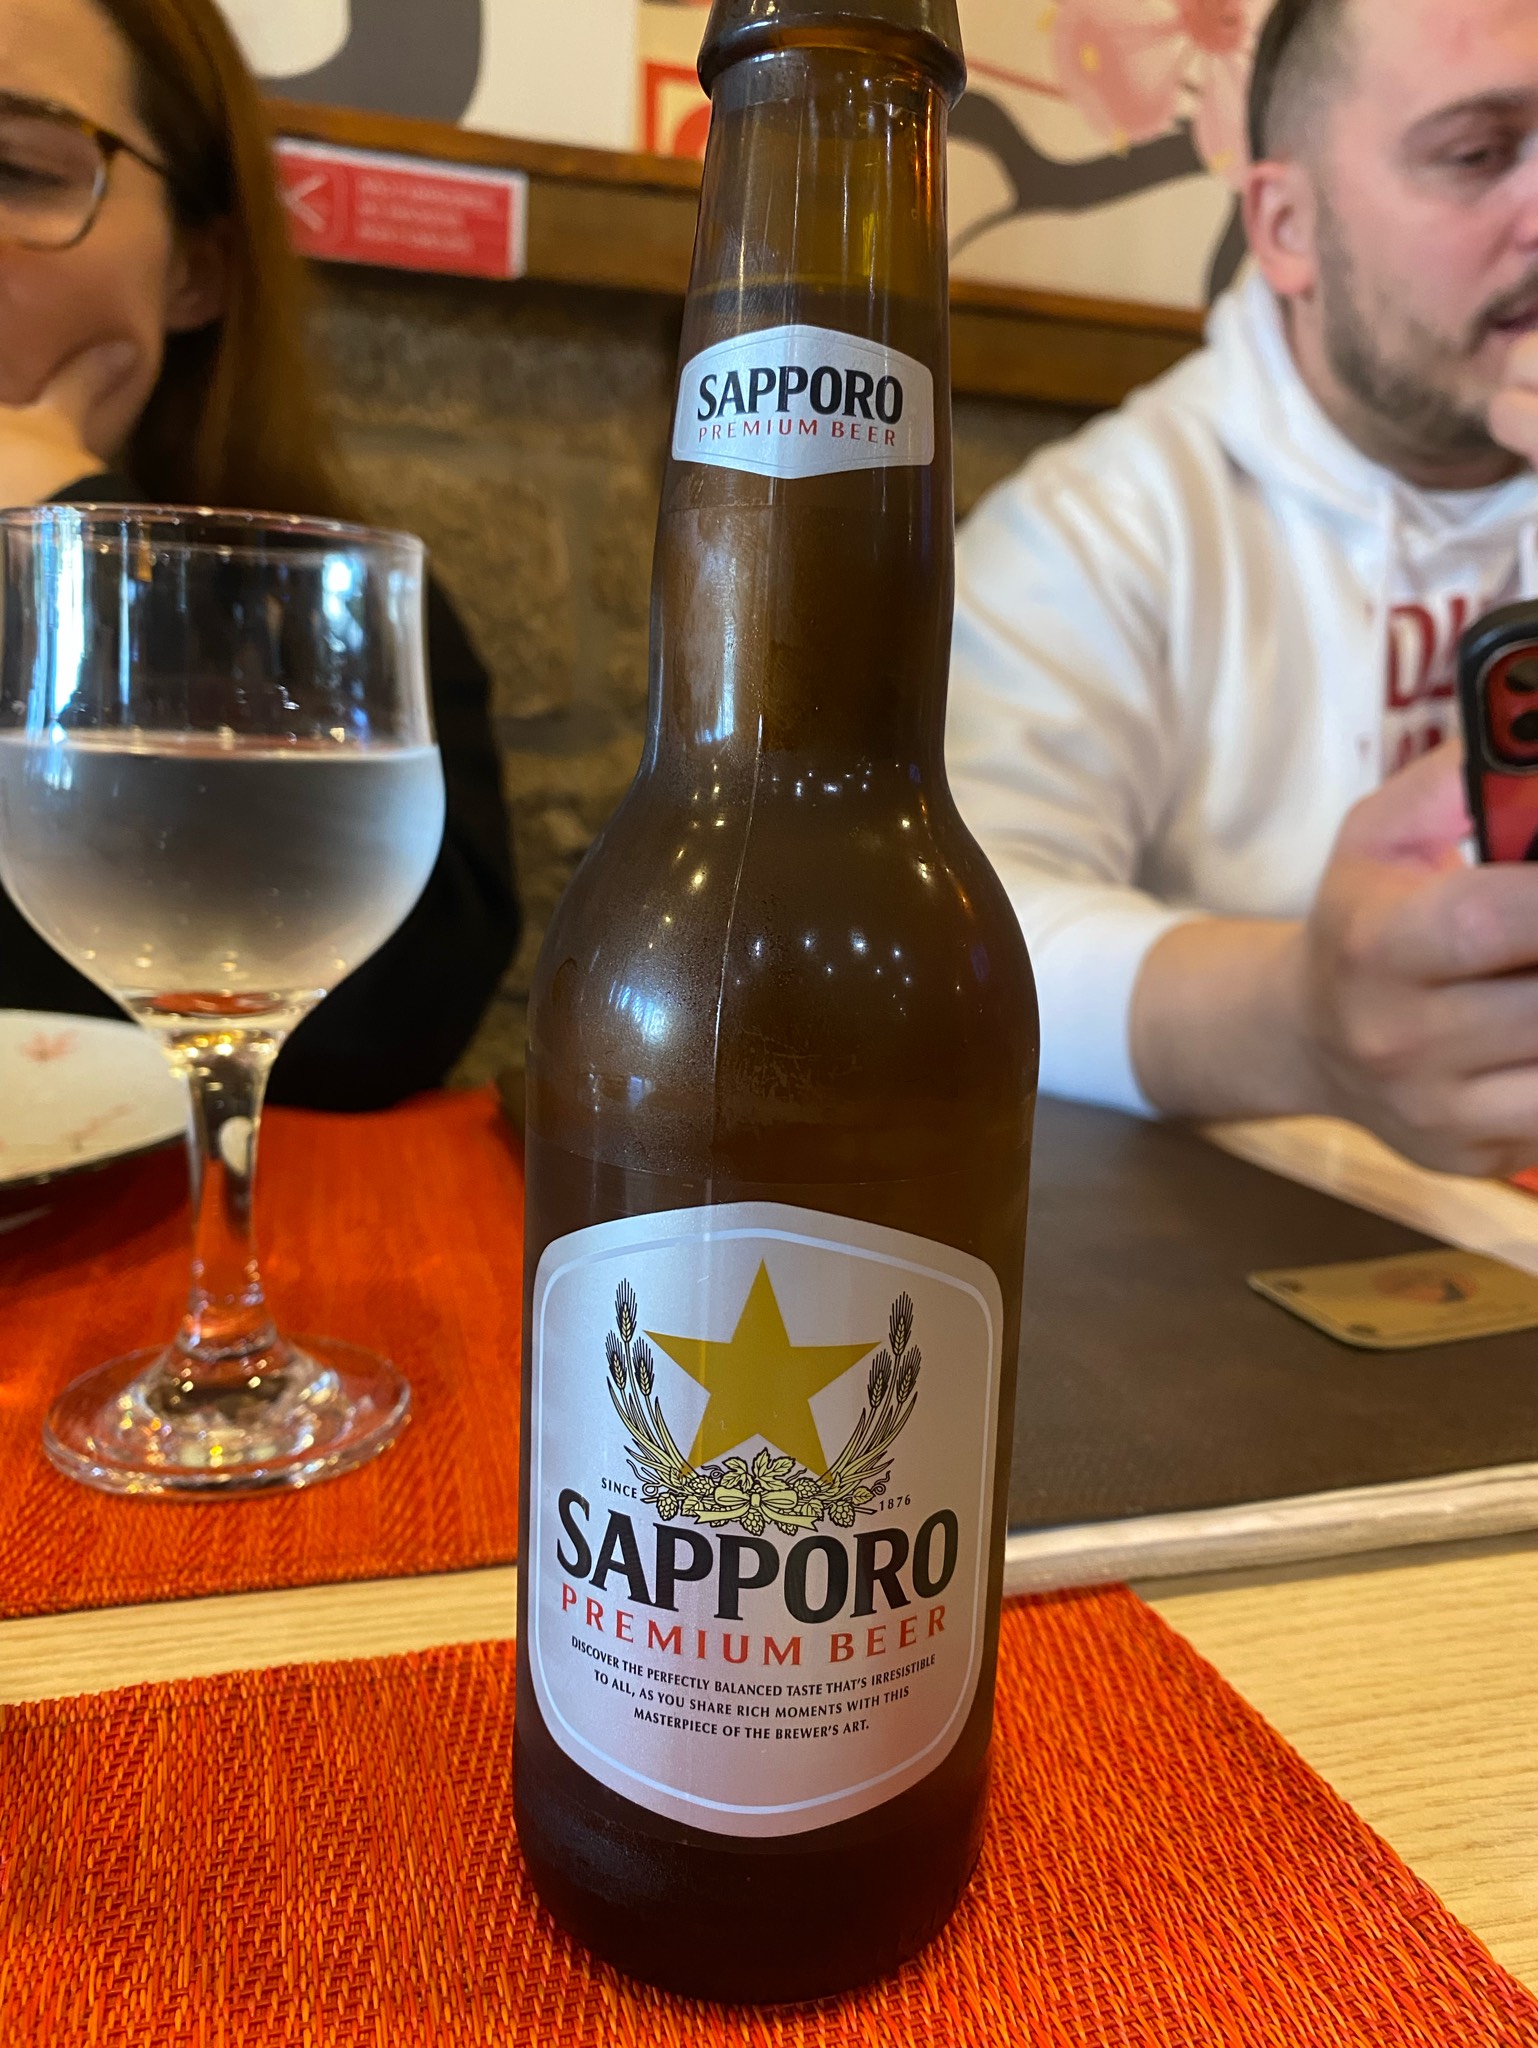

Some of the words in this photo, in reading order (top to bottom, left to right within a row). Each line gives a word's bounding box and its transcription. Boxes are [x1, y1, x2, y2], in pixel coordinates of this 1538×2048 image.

[697, 365, 903, 424] SAPPORO
[698, 418, 817, 443] PREMIUM
[831, 421, 895, 446] BEER
[600, 1477, 637, 1498] SINCE
[878, 1494, 911, 1511] 1876
[556, 1487, 958, 1623] SAPPORO
[560, 1582, 800, 1665] PREMIUM
[829, 1604, 946, 1662] BEER
[571, 1635, 619, 1668] DISCOVER
[622, 1659, 642, 1676] THE
[647, 1667, 709, 1689] PERFECTLY
[714, 1681, 782, 1696] BALANCED
[786, 1684, 822, 1696] TASTE
[826, 1677, 866, 1693] THAT'S
[871, 1653, 935, 1685] IRRESISTIBLE
[594, 1669, 607, 1684] TO
[611, 1678, 635, 1697] ALL,
[639, 1688, 653, 1700] AS
[657, 1692, 684, 1707] YOU
[689, 1698, 731, 1714] SHARE
[736, 1705, 769, 1717] RICH
[775, 1702, 841, 1717] MOMENTS
[846, 1697, 879, 1711] WITH
[883, 1685, 909, 1703] THIS
[634, 1707, 717, 1734] MASTERPIECE
[722, 1725, 740, 1737] OF
[744, 1727, 770, 1738] THE
[775, 1724, 838, 1739] BREWER'S
[842, 1719, 869, 1733] ART.
